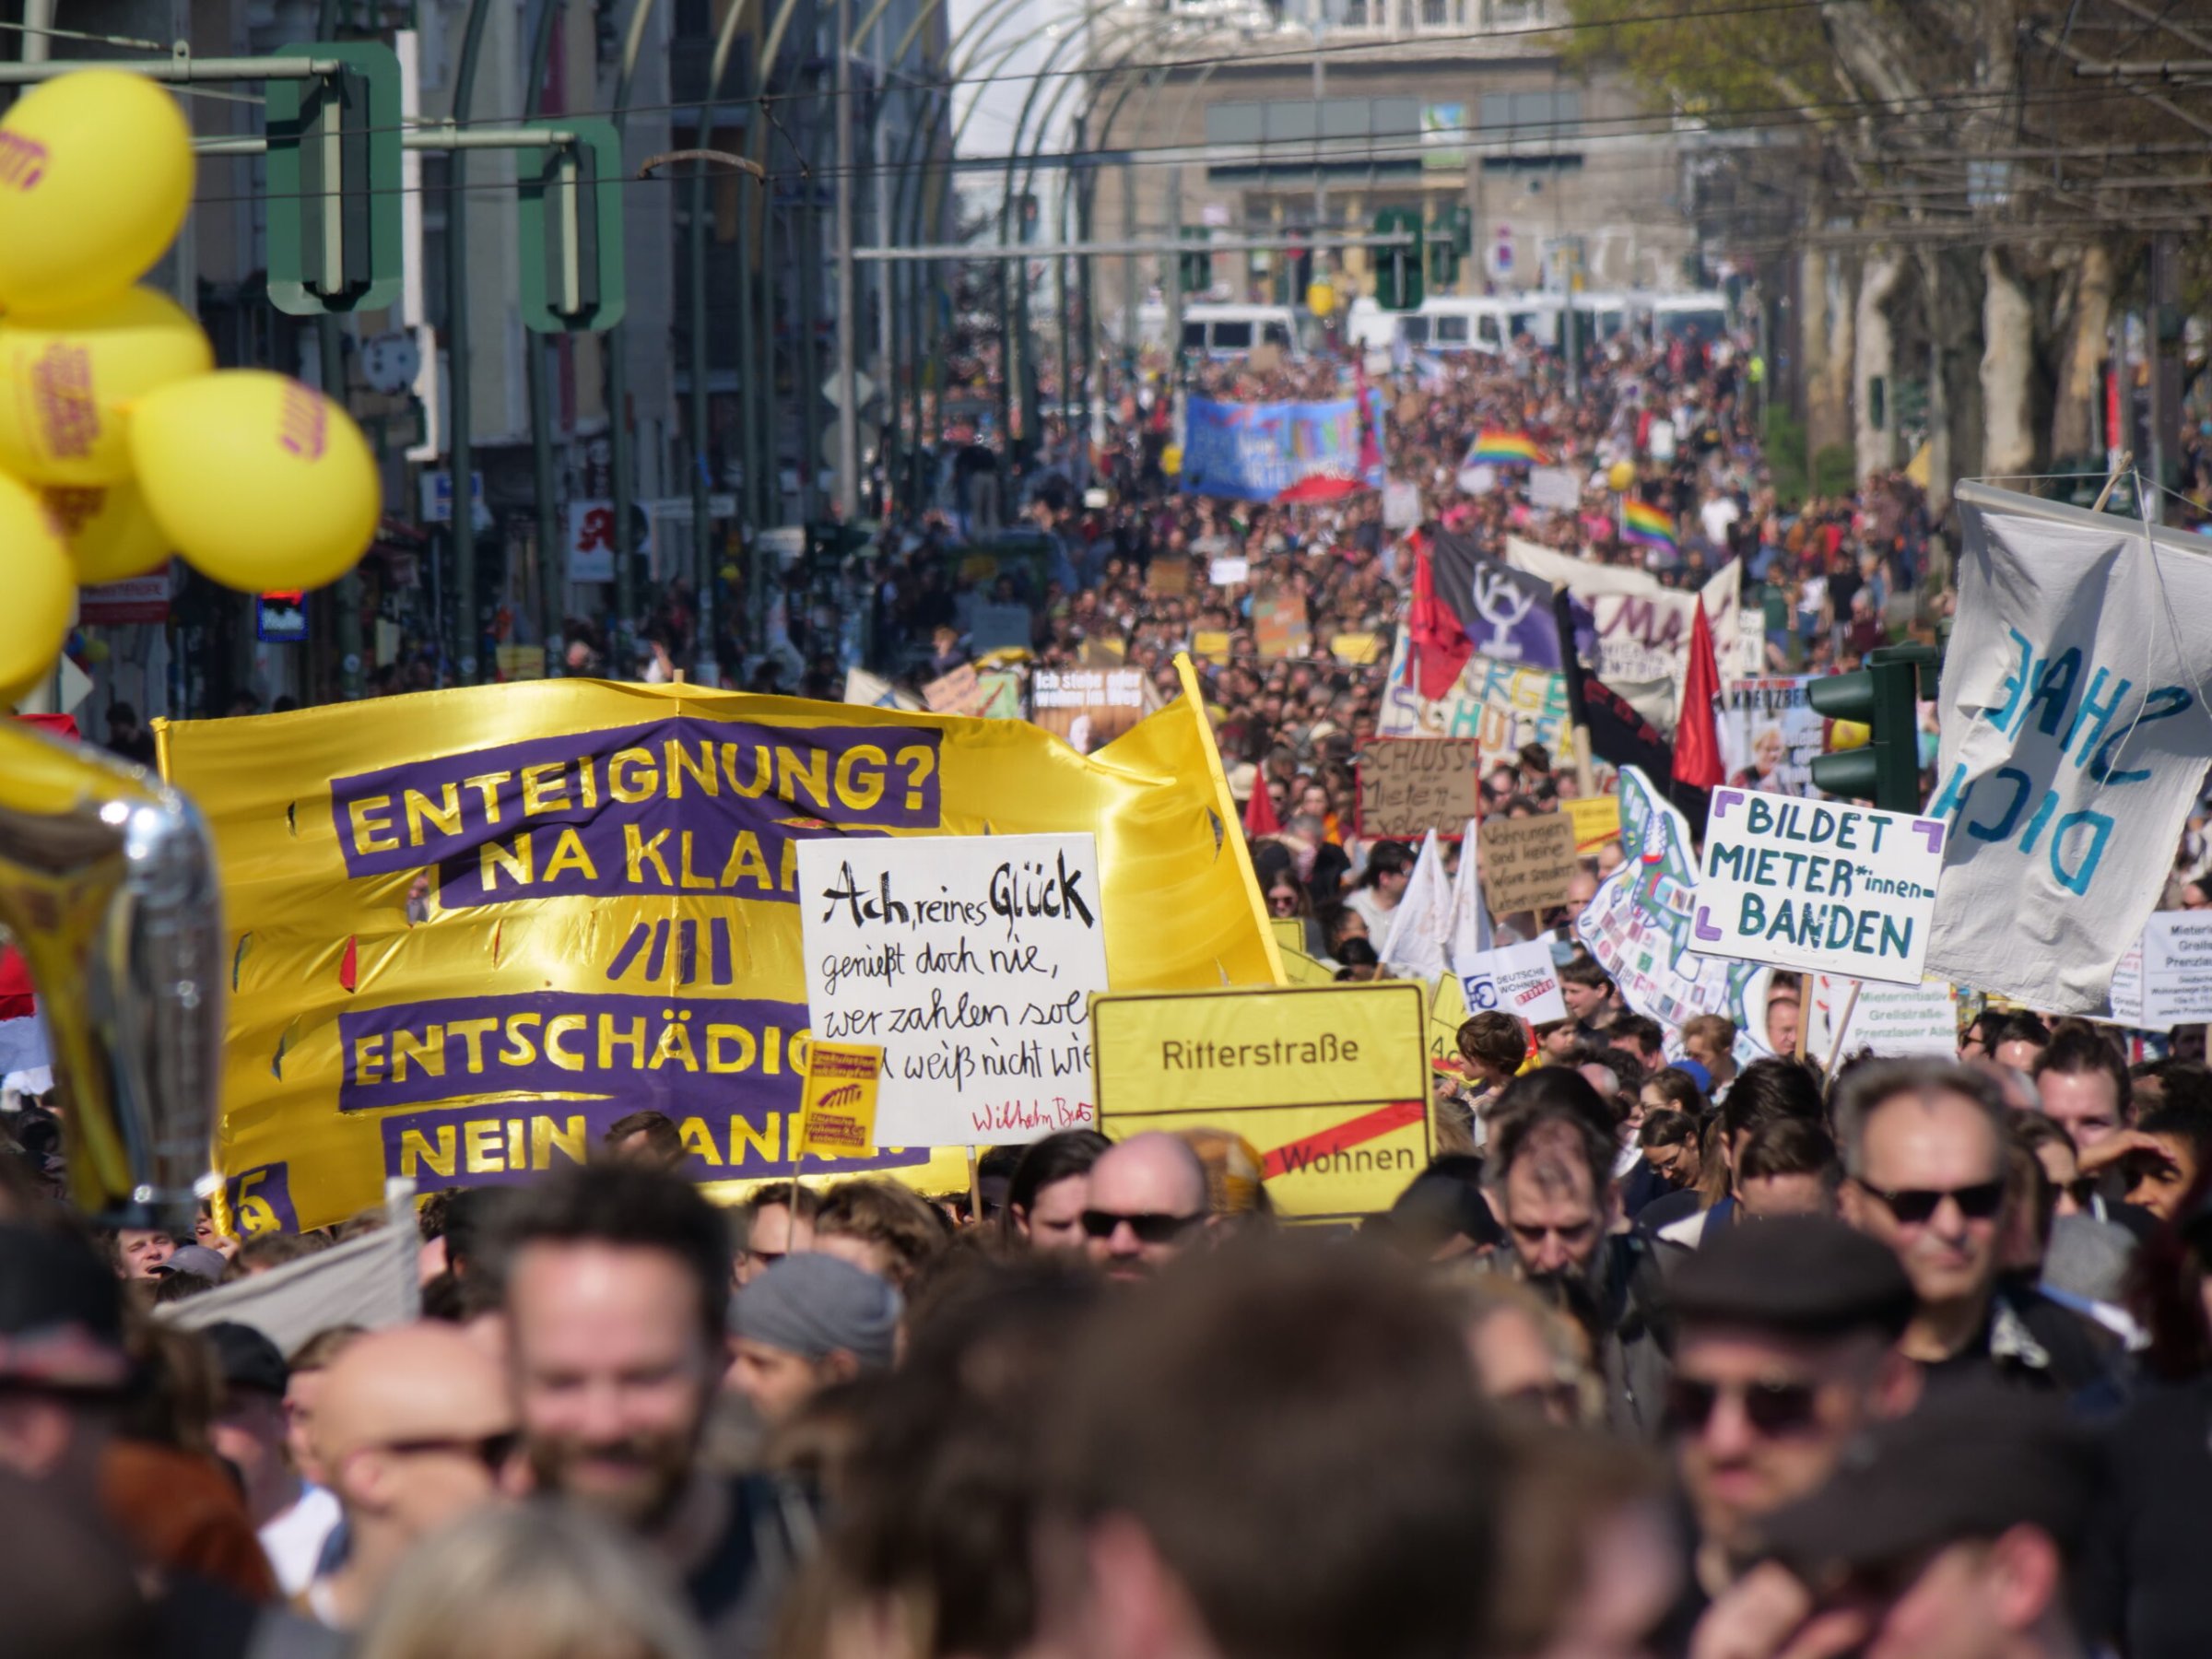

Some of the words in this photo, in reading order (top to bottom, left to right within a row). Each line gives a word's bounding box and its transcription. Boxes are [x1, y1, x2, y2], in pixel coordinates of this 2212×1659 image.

[1360, 740, 1473, 772] SCHLUSS
[348, 739, 935, 855] ENTEIGNUNG?
[1360, 780, 1463, 807] Mieten-
[1747, 797, 1893, 853] BILDET
[480, 828, 598, 891] NA
[914, 886, 987, 926] reines
[990, 848, 1095, 943] Glück
[1737, 891, 1913, 959] BANDEN
[822, 942, 906, 995] genießt
[916, 936, 984, 975] doch
[990, 934, 1058, 979] nie,
[1497, 966, 1547, 984] DEUTSCHE
[1499, 978, 1542, 995] WOHNEN
[824, 1006, 883, 1038] wer
[888, 988, 1008, 1033] zahlen
[1860, 991, 1947, 1003] Mieterinitiativ
[904, 1040, 975, 1092] weiß
[982, 1037, 1042, 1077] nicht
[1161, 1032, 1359, 1071] Ritterstraße
[401, 1115, 587, 1177] NEIN
[1279, 1143, 1415, 1175] Wohnen
